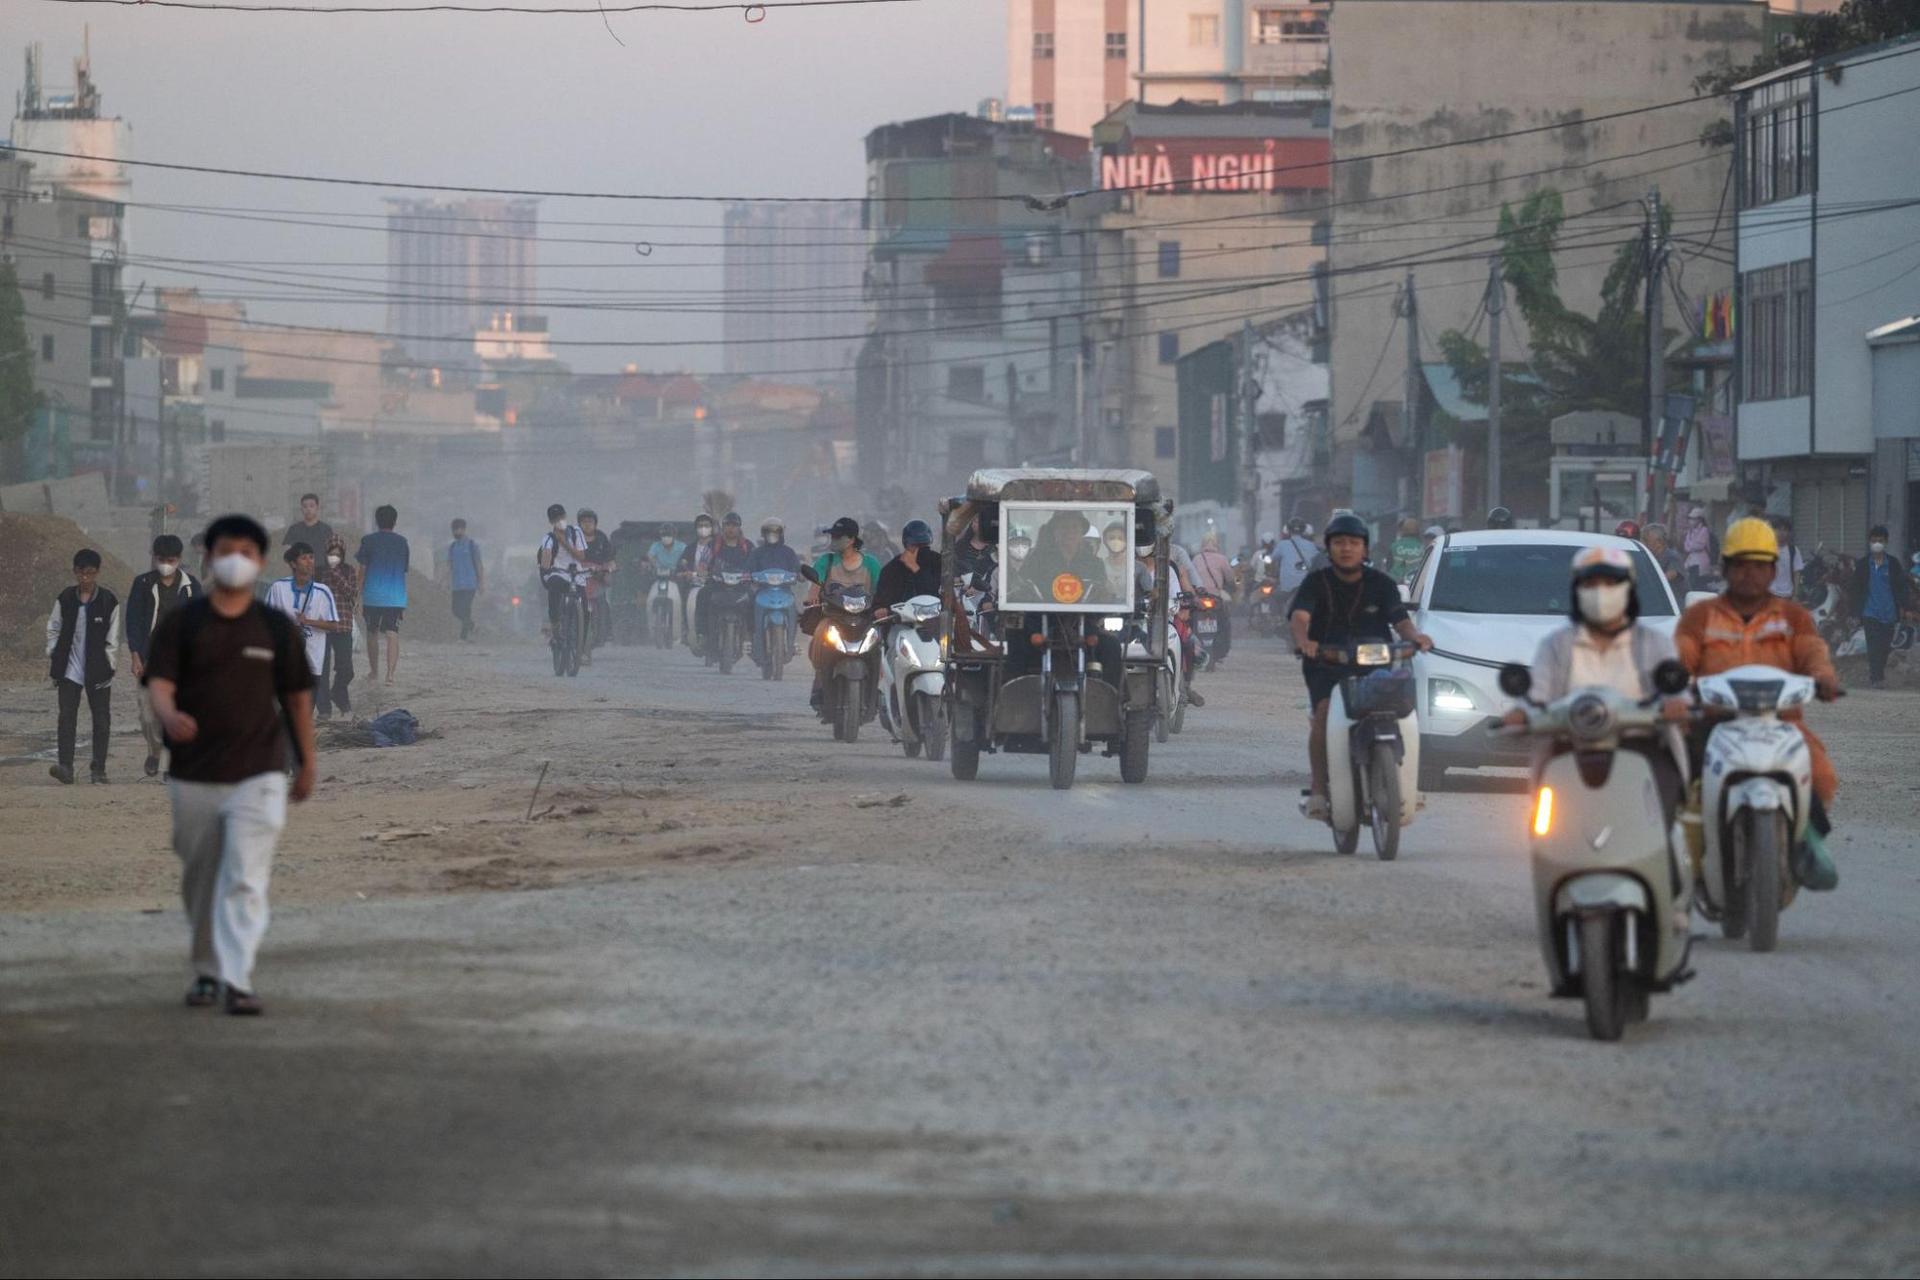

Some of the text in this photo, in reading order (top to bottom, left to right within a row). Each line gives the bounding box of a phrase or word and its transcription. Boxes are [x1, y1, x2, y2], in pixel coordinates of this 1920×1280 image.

[1103, 139, 1274, 190] NHÀ NGHỈ
[1396, 545, 1420, 556] Grab
